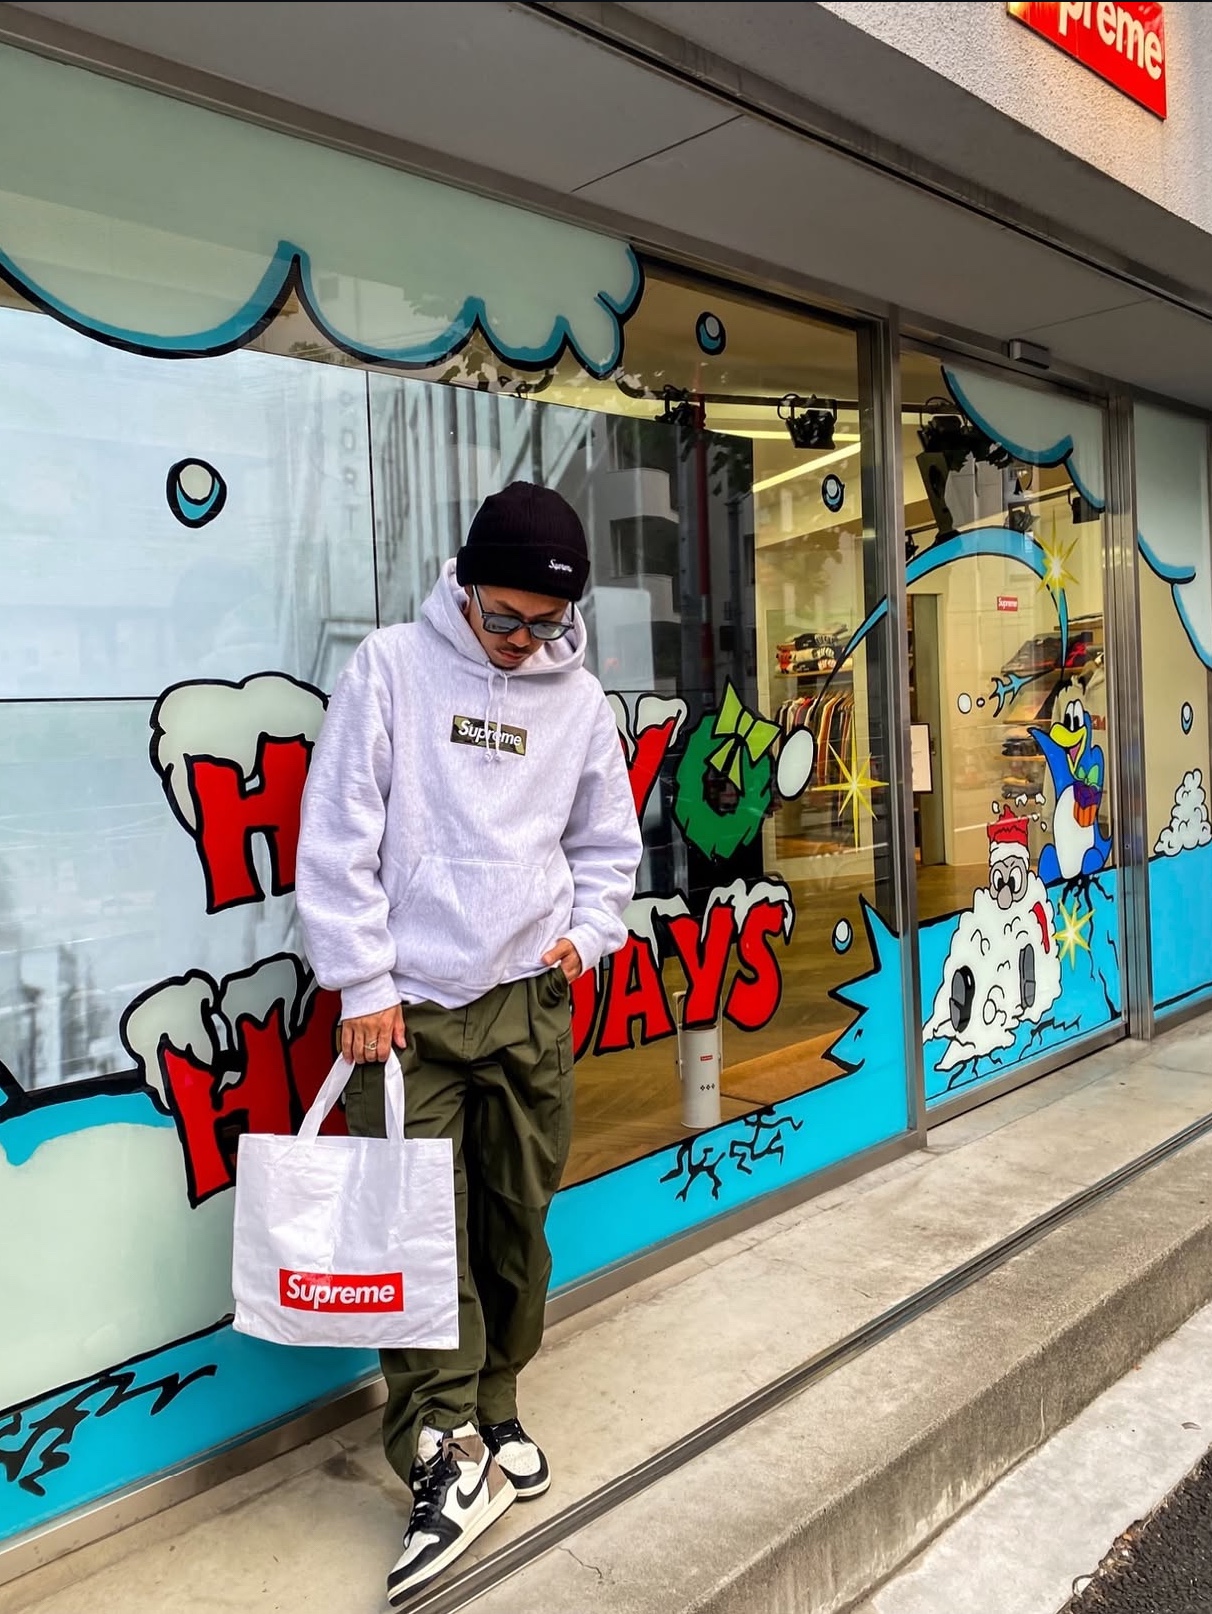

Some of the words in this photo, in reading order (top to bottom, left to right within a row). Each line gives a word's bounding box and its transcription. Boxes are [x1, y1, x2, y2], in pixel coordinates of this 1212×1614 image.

[1058, 2, 1163, 81] preme
[458, 720, 522, 746] Supreme
[286, 1273, 396, 1310] Supreme
